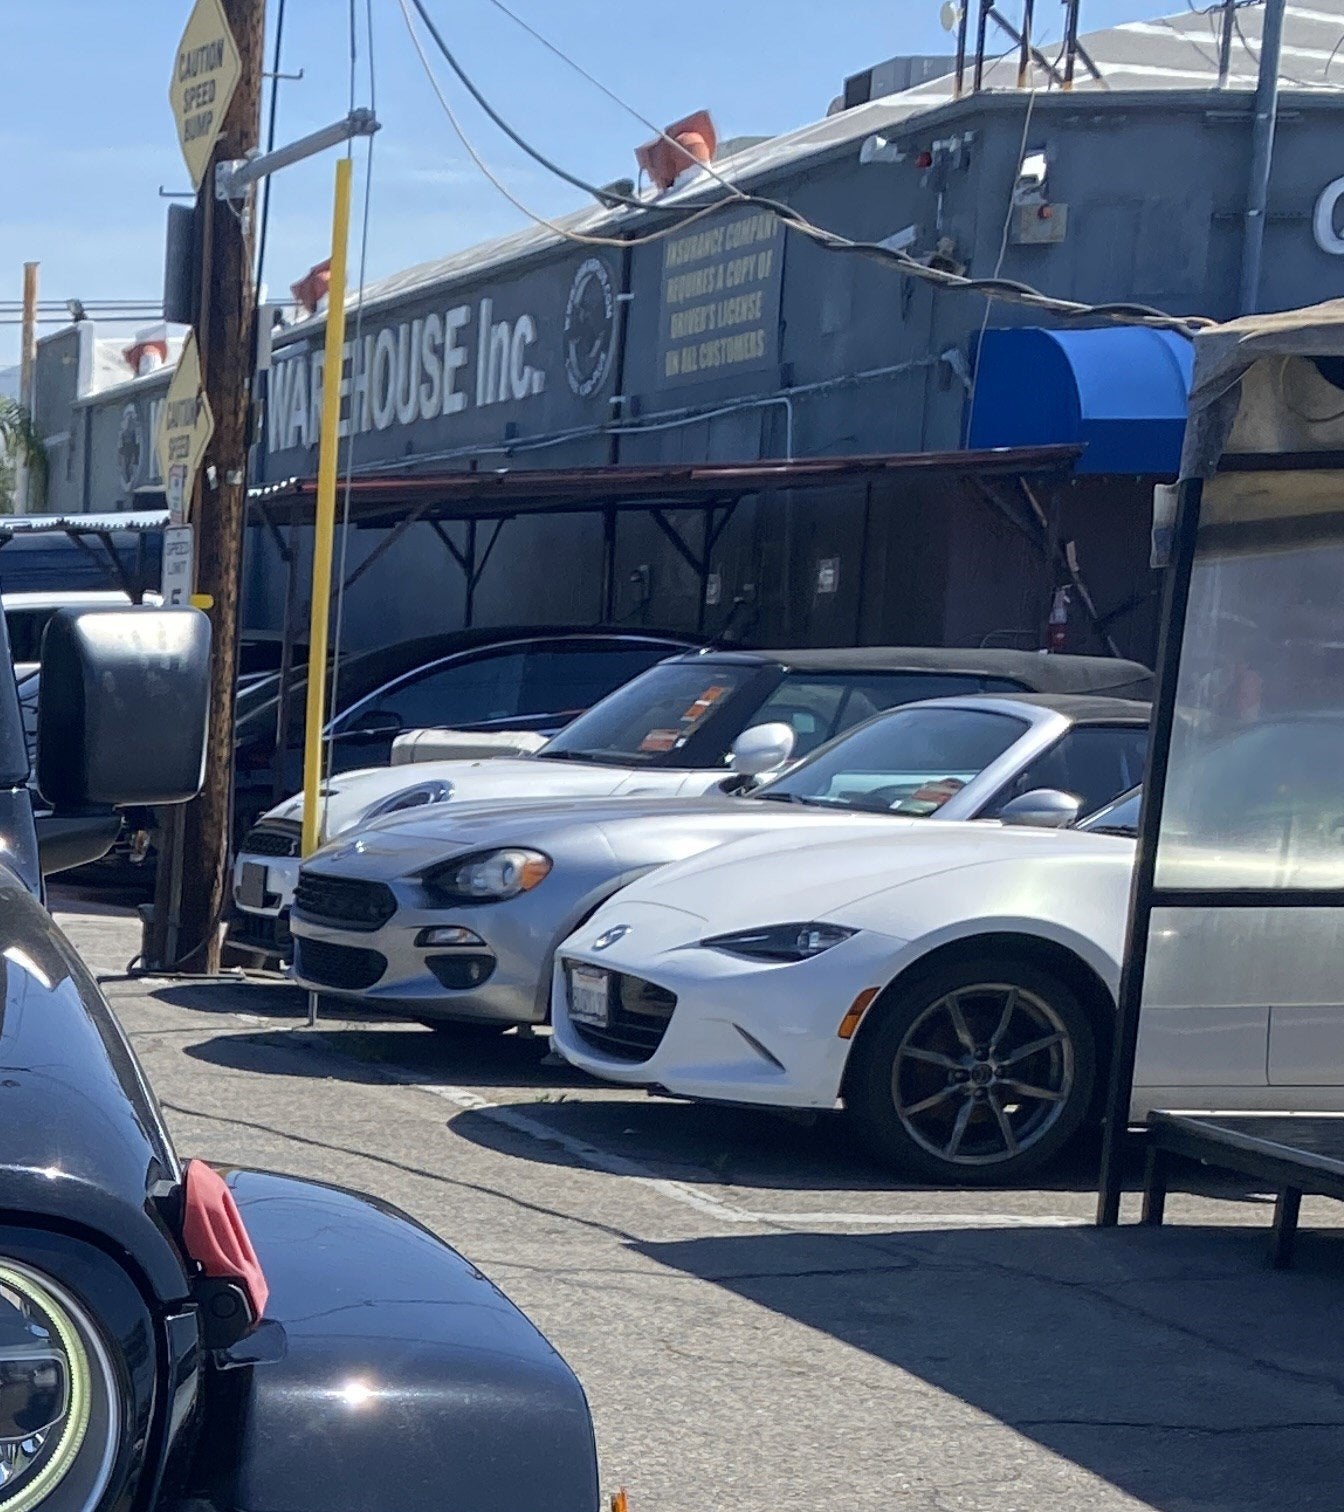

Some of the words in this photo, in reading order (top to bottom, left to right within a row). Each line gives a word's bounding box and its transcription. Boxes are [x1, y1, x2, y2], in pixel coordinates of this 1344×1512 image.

[179, 38, 225, 83] CAUTION
[183, 79, 216, 114] SPEED
[726, 254, 757, 289] COPY
[476, 297, 546, 407] Inc.
[166, 541, 190, 556] SPEED
